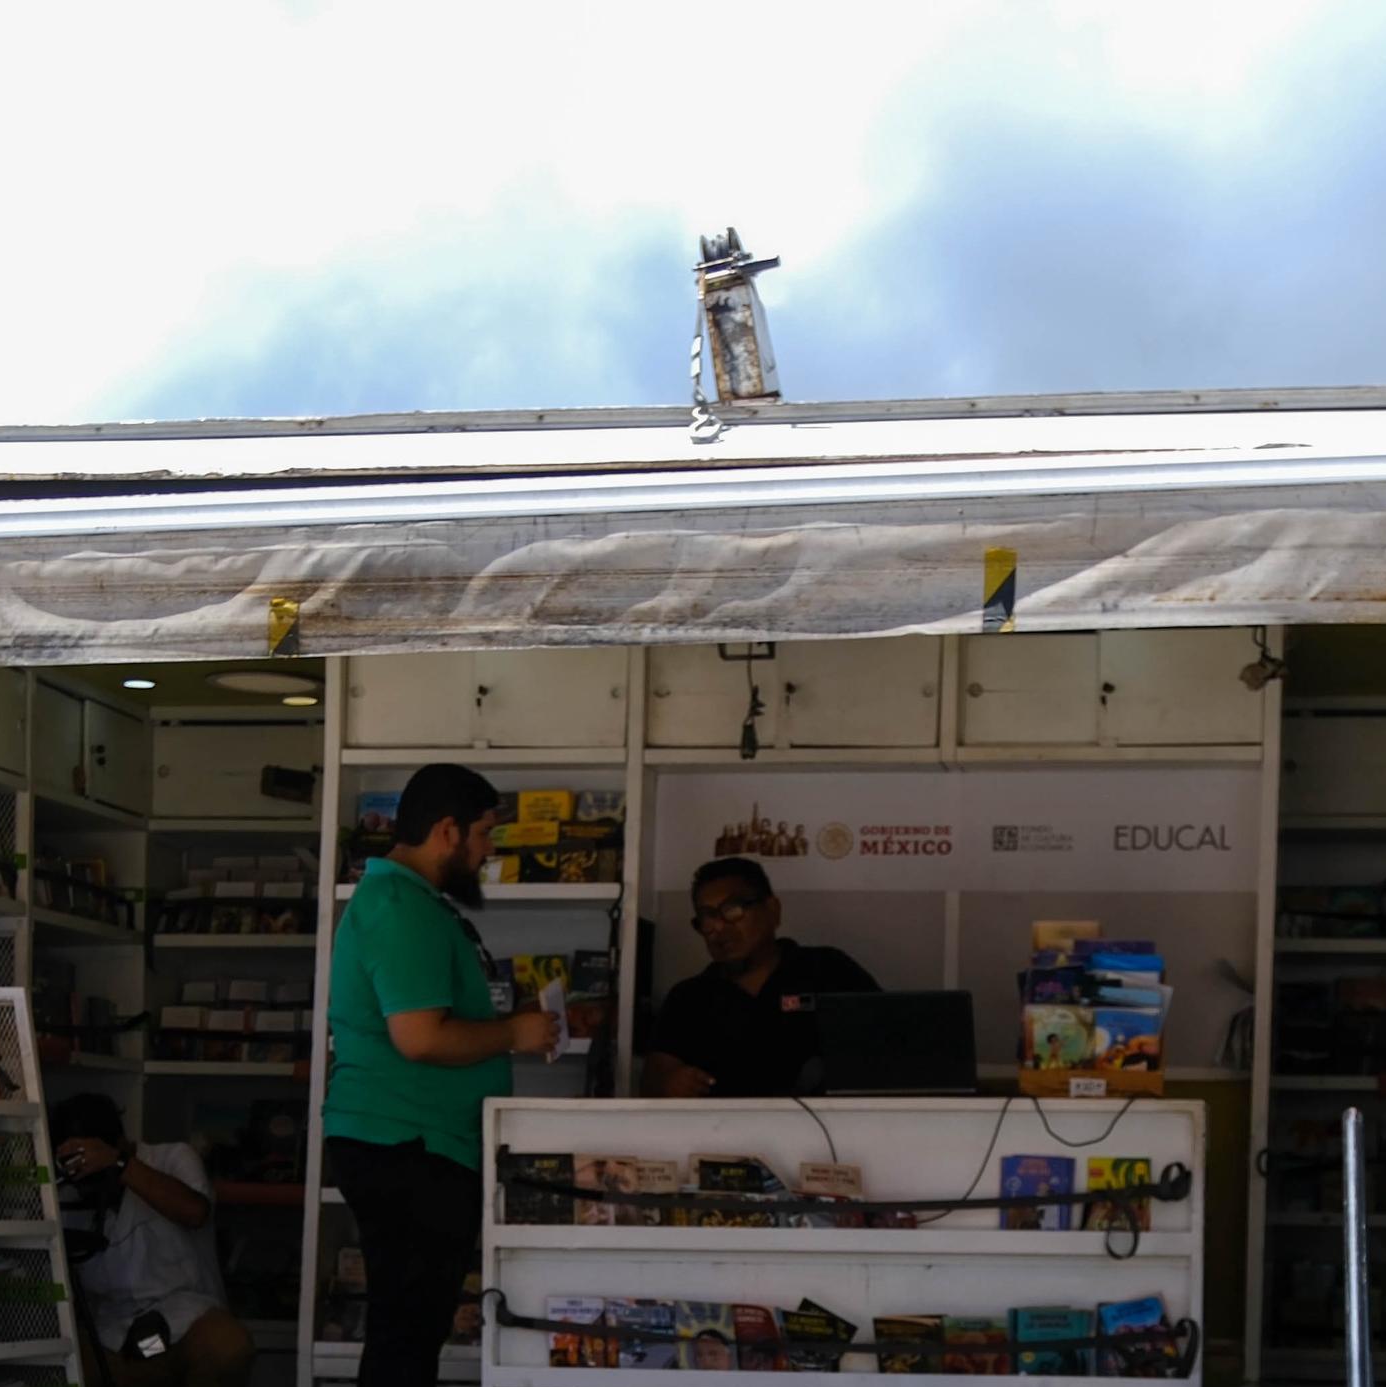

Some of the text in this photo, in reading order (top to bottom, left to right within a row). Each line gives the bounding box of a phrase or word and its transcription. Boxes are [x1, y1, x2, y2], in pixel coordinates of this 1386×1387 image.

[859, 826, 953, 837] GOBIERNO DE
[1114, 824, 1232, 852] EDUCAL
[859, 836, 953, 856] MÉXICO
